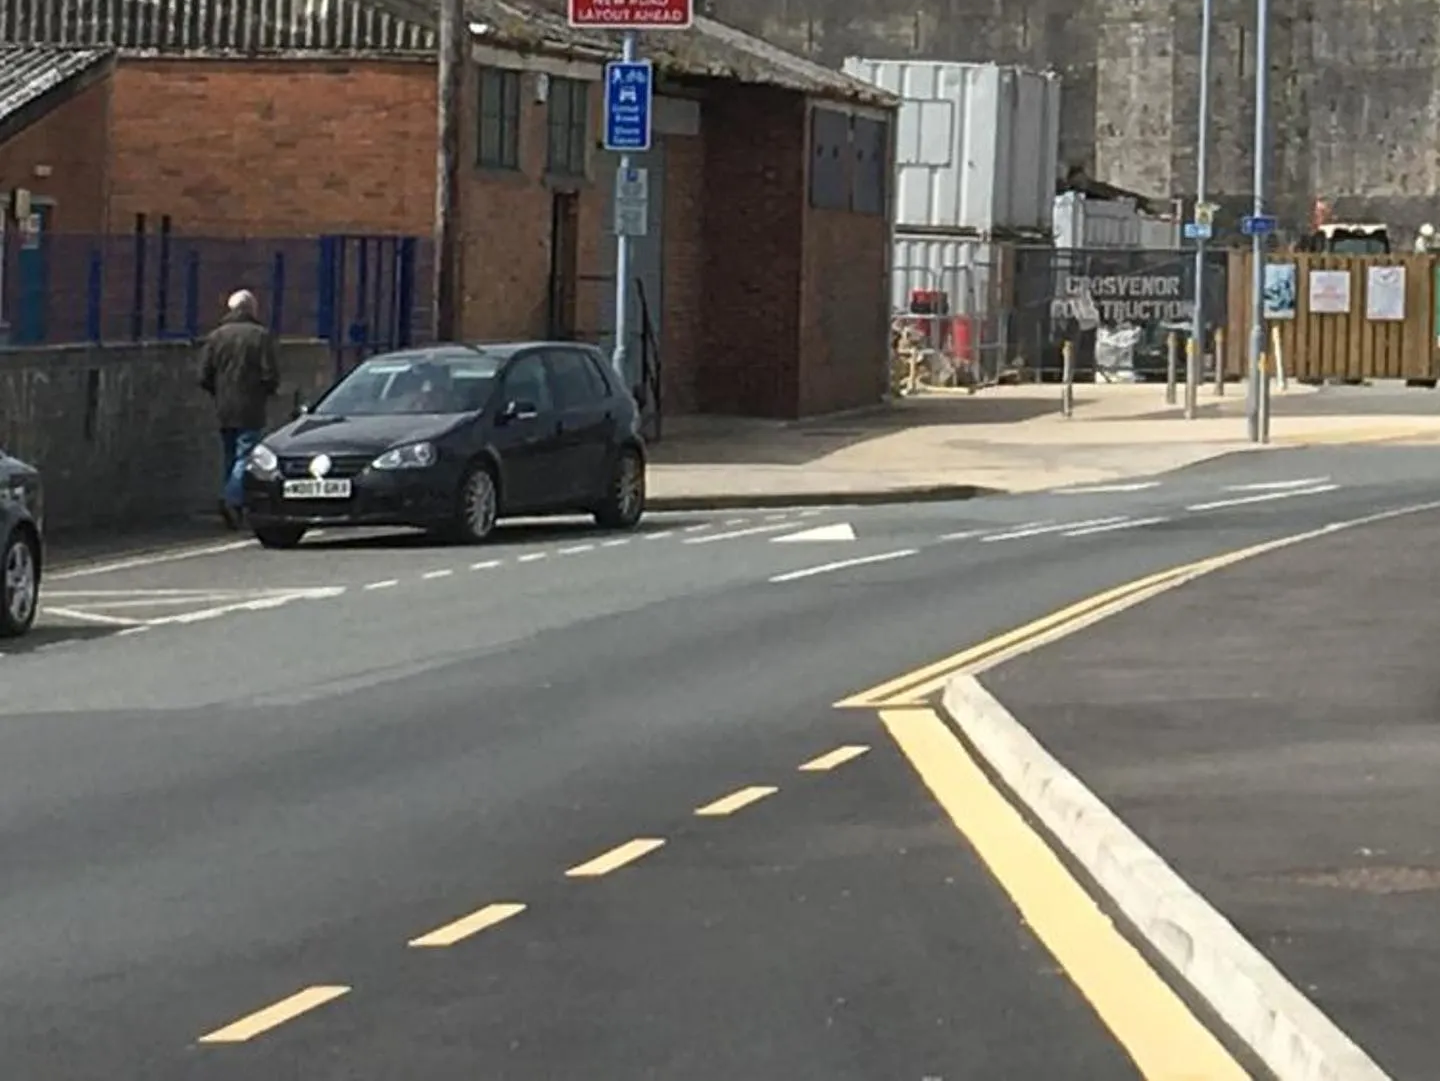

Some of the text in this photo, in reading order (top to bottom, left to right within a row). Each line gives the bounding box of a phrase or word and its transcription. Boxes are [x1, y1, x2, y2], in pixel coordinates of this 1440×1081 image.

[578, 8, 683, 21] LAYOUT AHEAD
[1065, 276, 1179, 296] GROSVENOR
